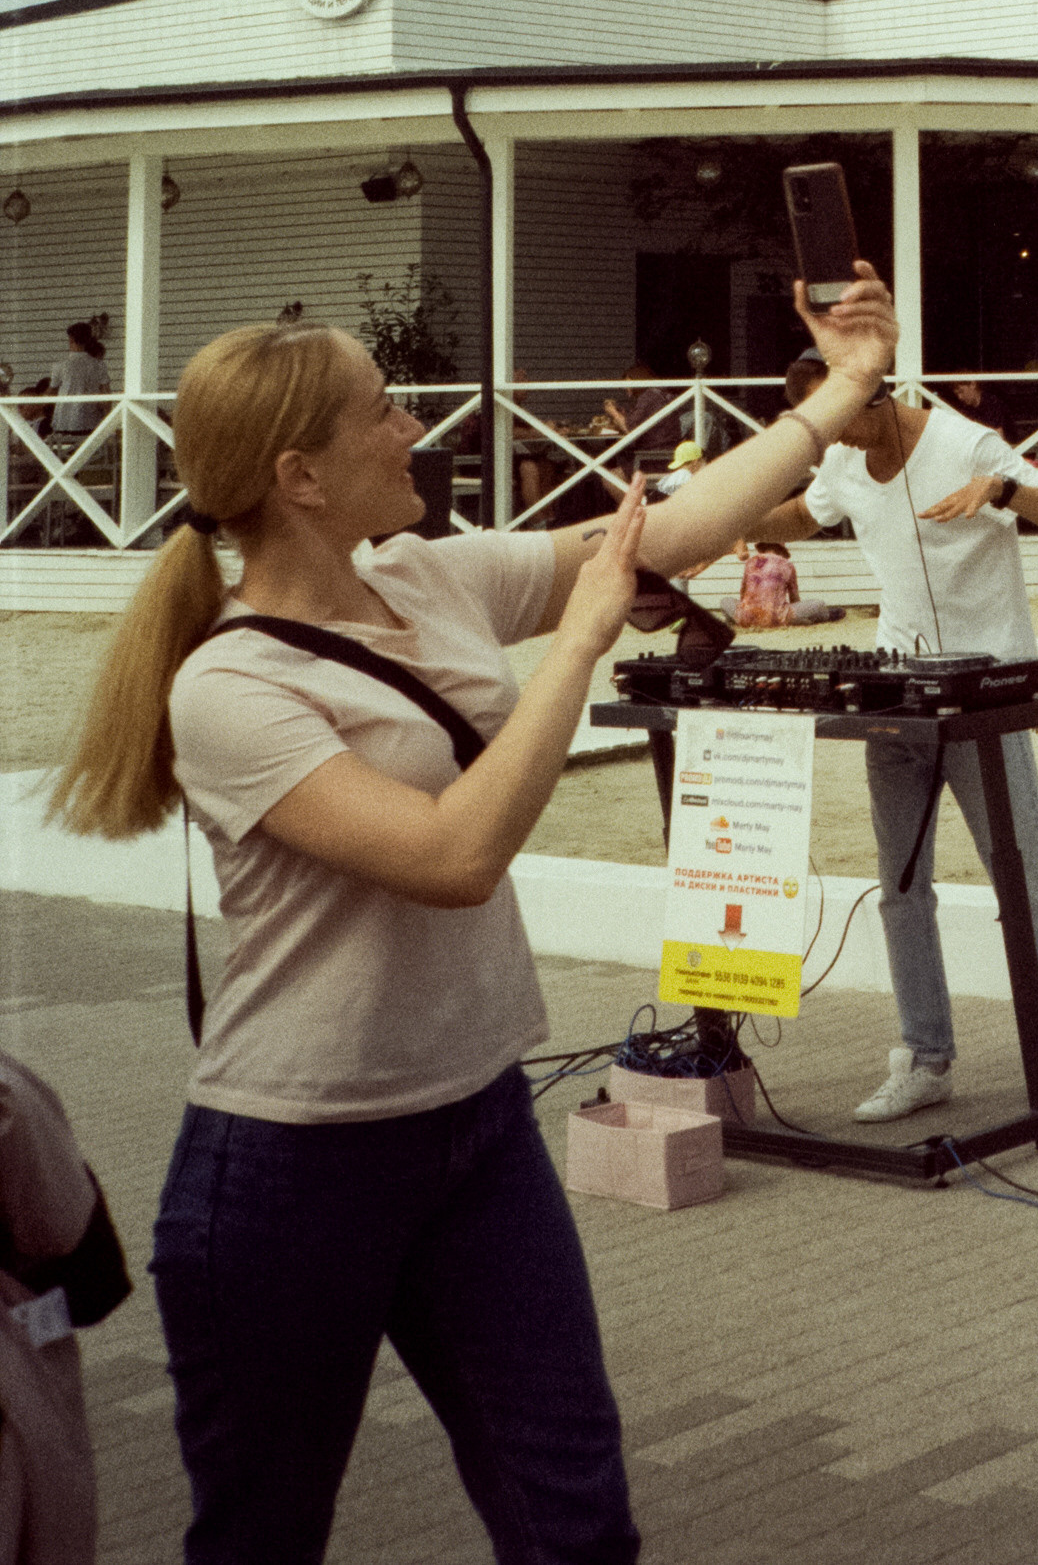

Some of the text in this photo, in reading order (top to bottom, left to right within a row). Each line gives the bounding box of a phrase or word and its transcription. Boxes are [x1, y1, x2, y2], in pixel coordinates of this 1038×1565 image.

[907, 677, 939, 685] Pioneer
[980, 674, 1028, 689] Pioneer
[675, 867, 779, 885] ПОДДЕРЖКА АРТИСТА
[674, 880, 779, 897] НА ДИСКИ И ПЛАСТИНКИ
